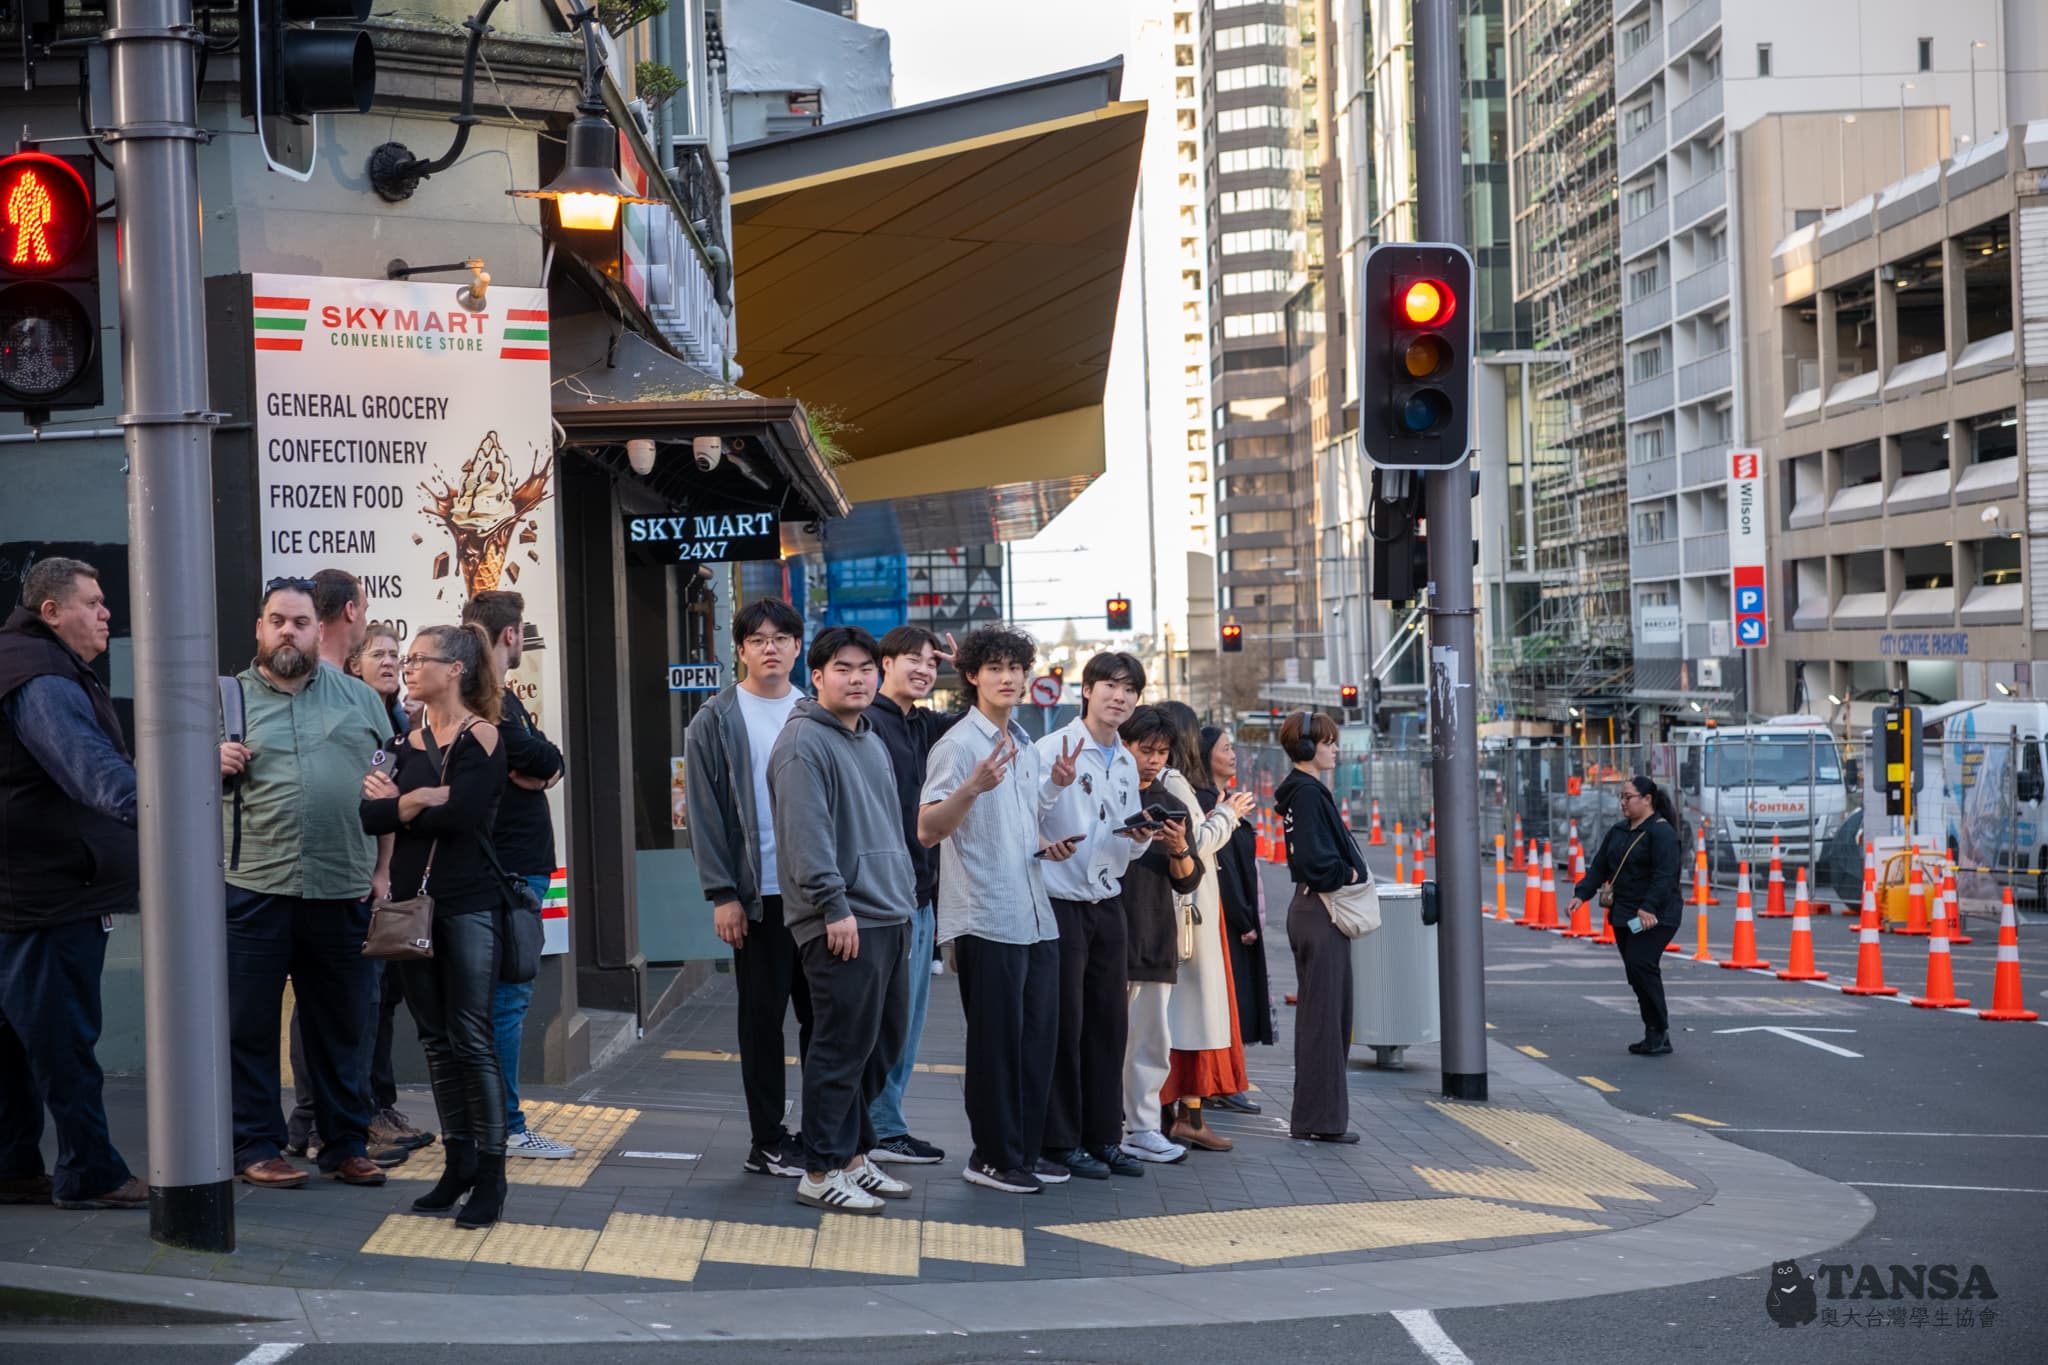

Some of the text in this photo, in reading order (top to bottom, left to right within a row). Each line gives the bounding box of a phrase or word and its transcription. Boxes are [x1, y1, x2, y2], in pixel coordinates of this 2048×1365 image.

[321, 305, 489, 335] SKYMART
[331, 332, 483, 352] CONVENIENCE STORE
[267, 393, 449, 420] GENERAL GROCERY
[268, 438, 427, 464] CONFECTIONERY
[270, 484, 403, 509] FROZEN FOOD
[1740, 482, 1752, 535] Wilson
[630, 512, 774, 541] SKY MART
[271, 530, 376, 554] ICE CREAM
[678, 541, 729, 560] 24X7
[1742, 591, 1757, 610] P
[671, 667, 718, 688] OPEN
